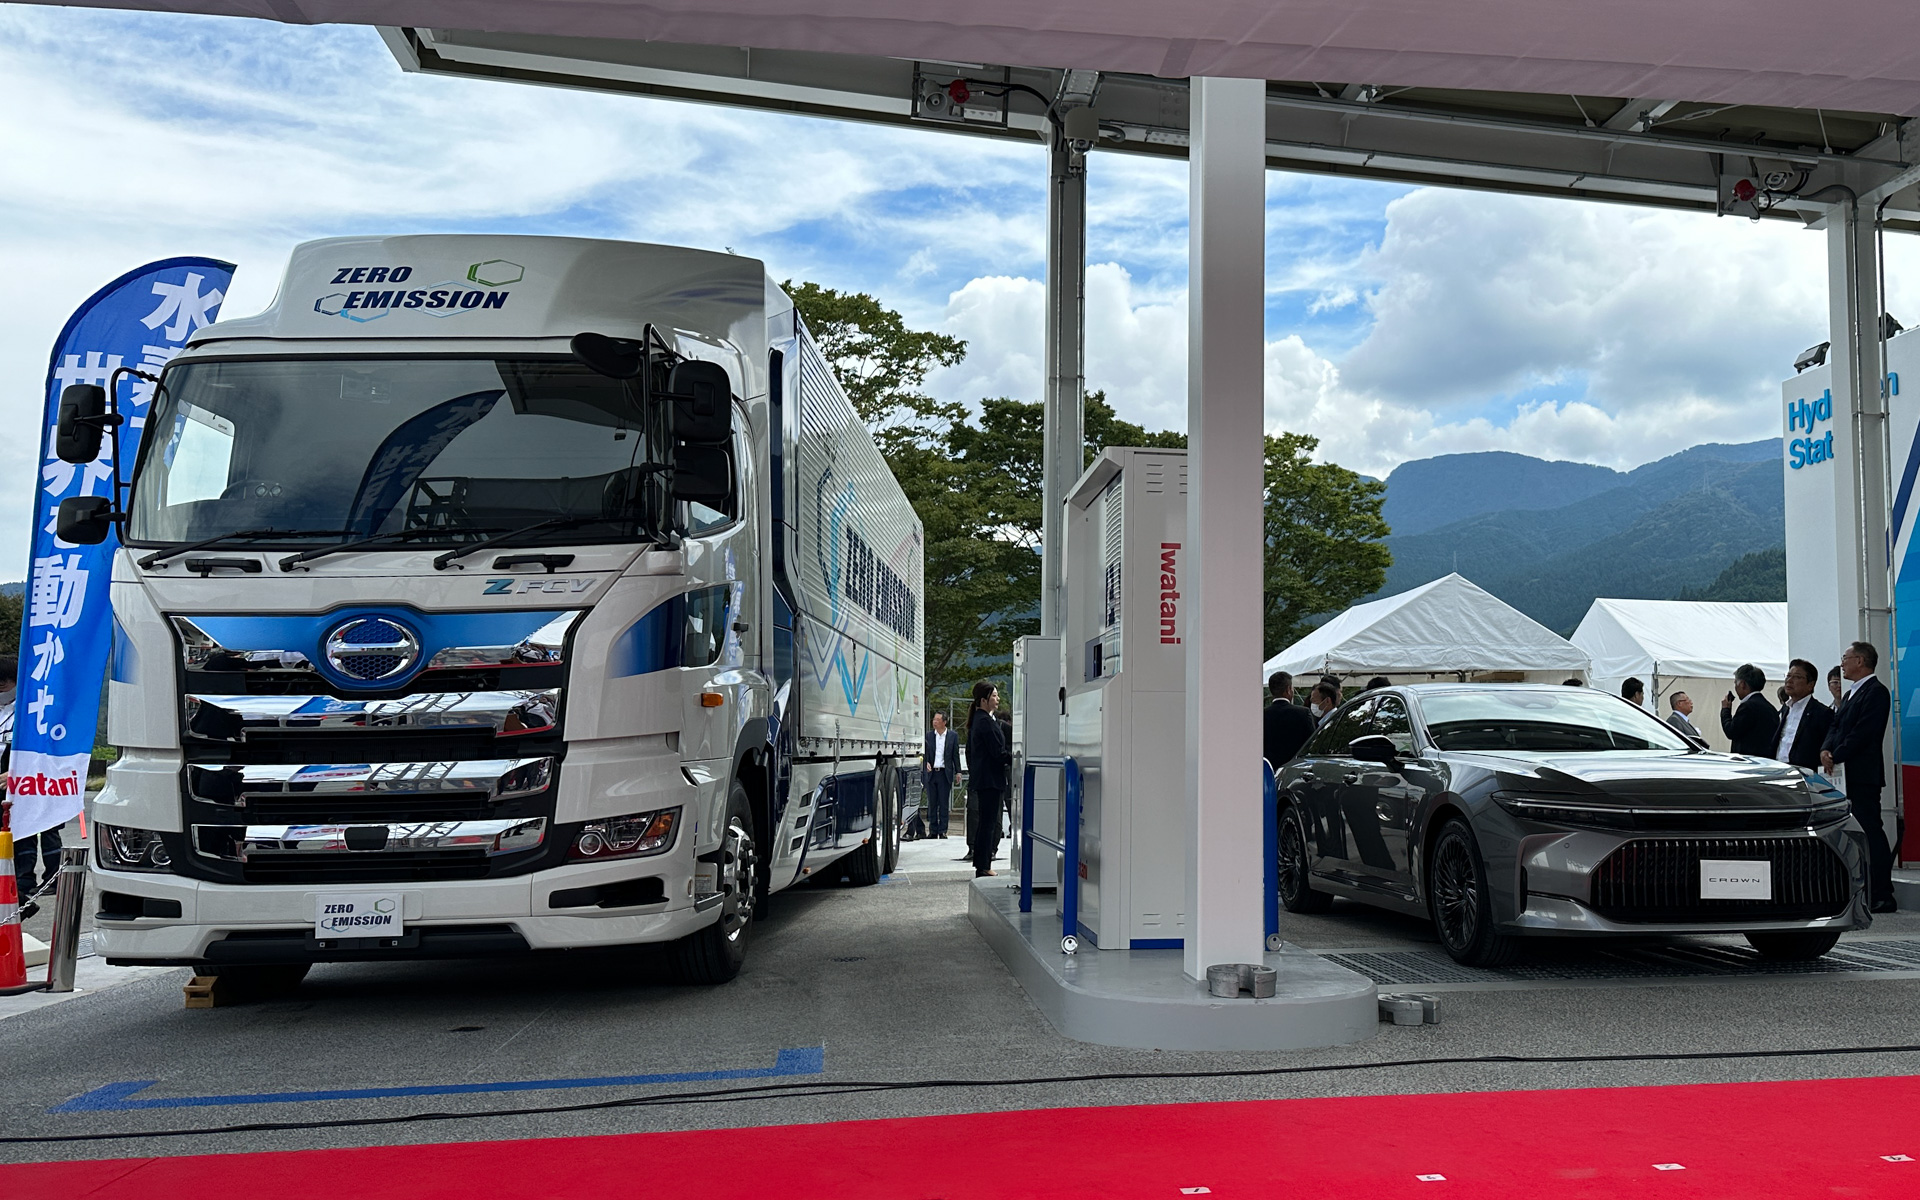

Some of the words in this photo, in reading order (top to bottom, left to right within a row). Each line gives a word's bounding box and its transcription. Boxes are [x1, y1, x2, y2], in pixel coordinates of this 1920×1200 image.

[330, 266, 412, 284] ZERO
[343, 290, 509, 309] EMISSION
[1789, 430, 1834, 470] Stat
[1160, 543, 1181, 644] Iwatani
[7, 770, 78, 797] watani
[324, 904, 354, 914] ZERO
[331, 915, 392, 926] EMISSION
